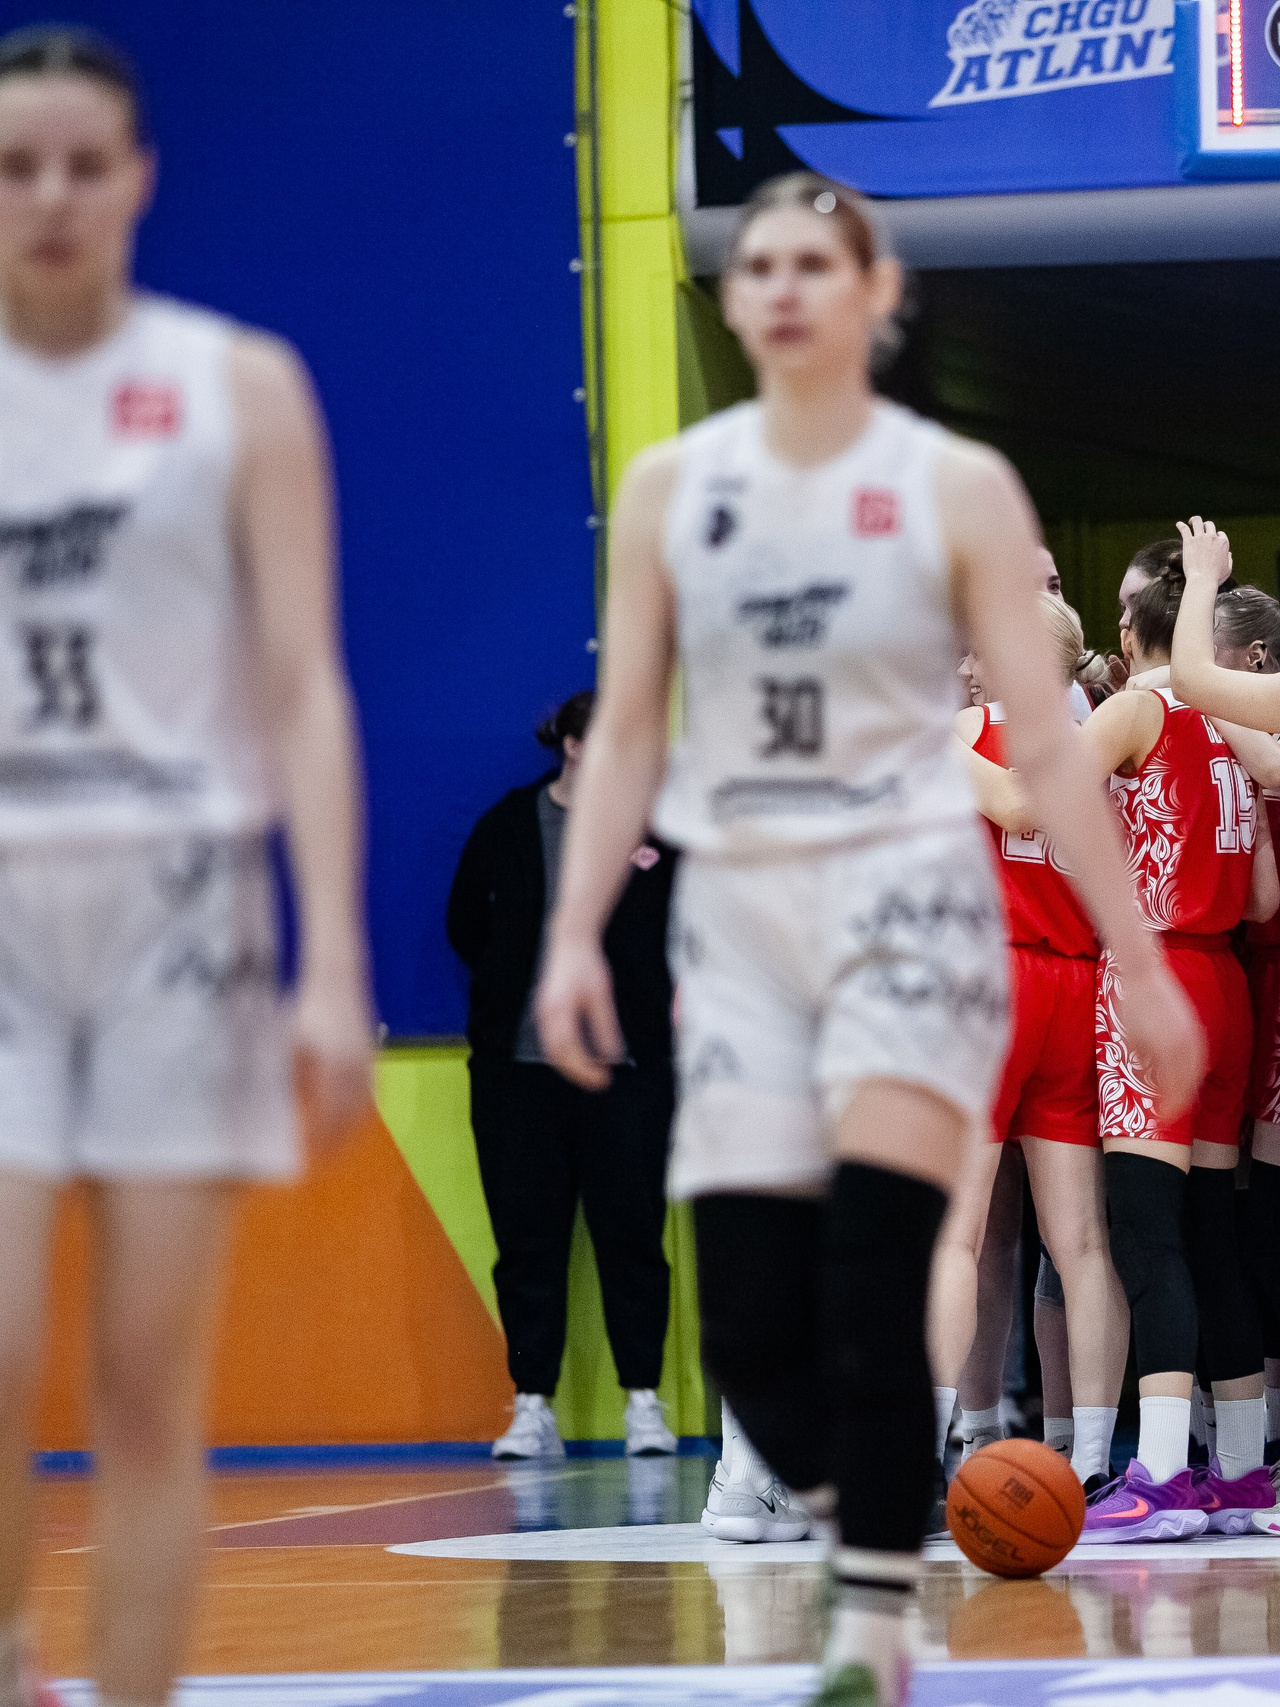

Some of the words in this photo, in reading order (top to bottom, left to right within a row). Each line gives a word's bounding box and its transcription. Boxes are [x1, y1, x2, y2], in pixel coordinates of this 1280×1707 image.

[1023, 0, 1148, 39] CHGU
[757, 676, 826, 759] 30
[1209, 757, 1257, 854] 15
